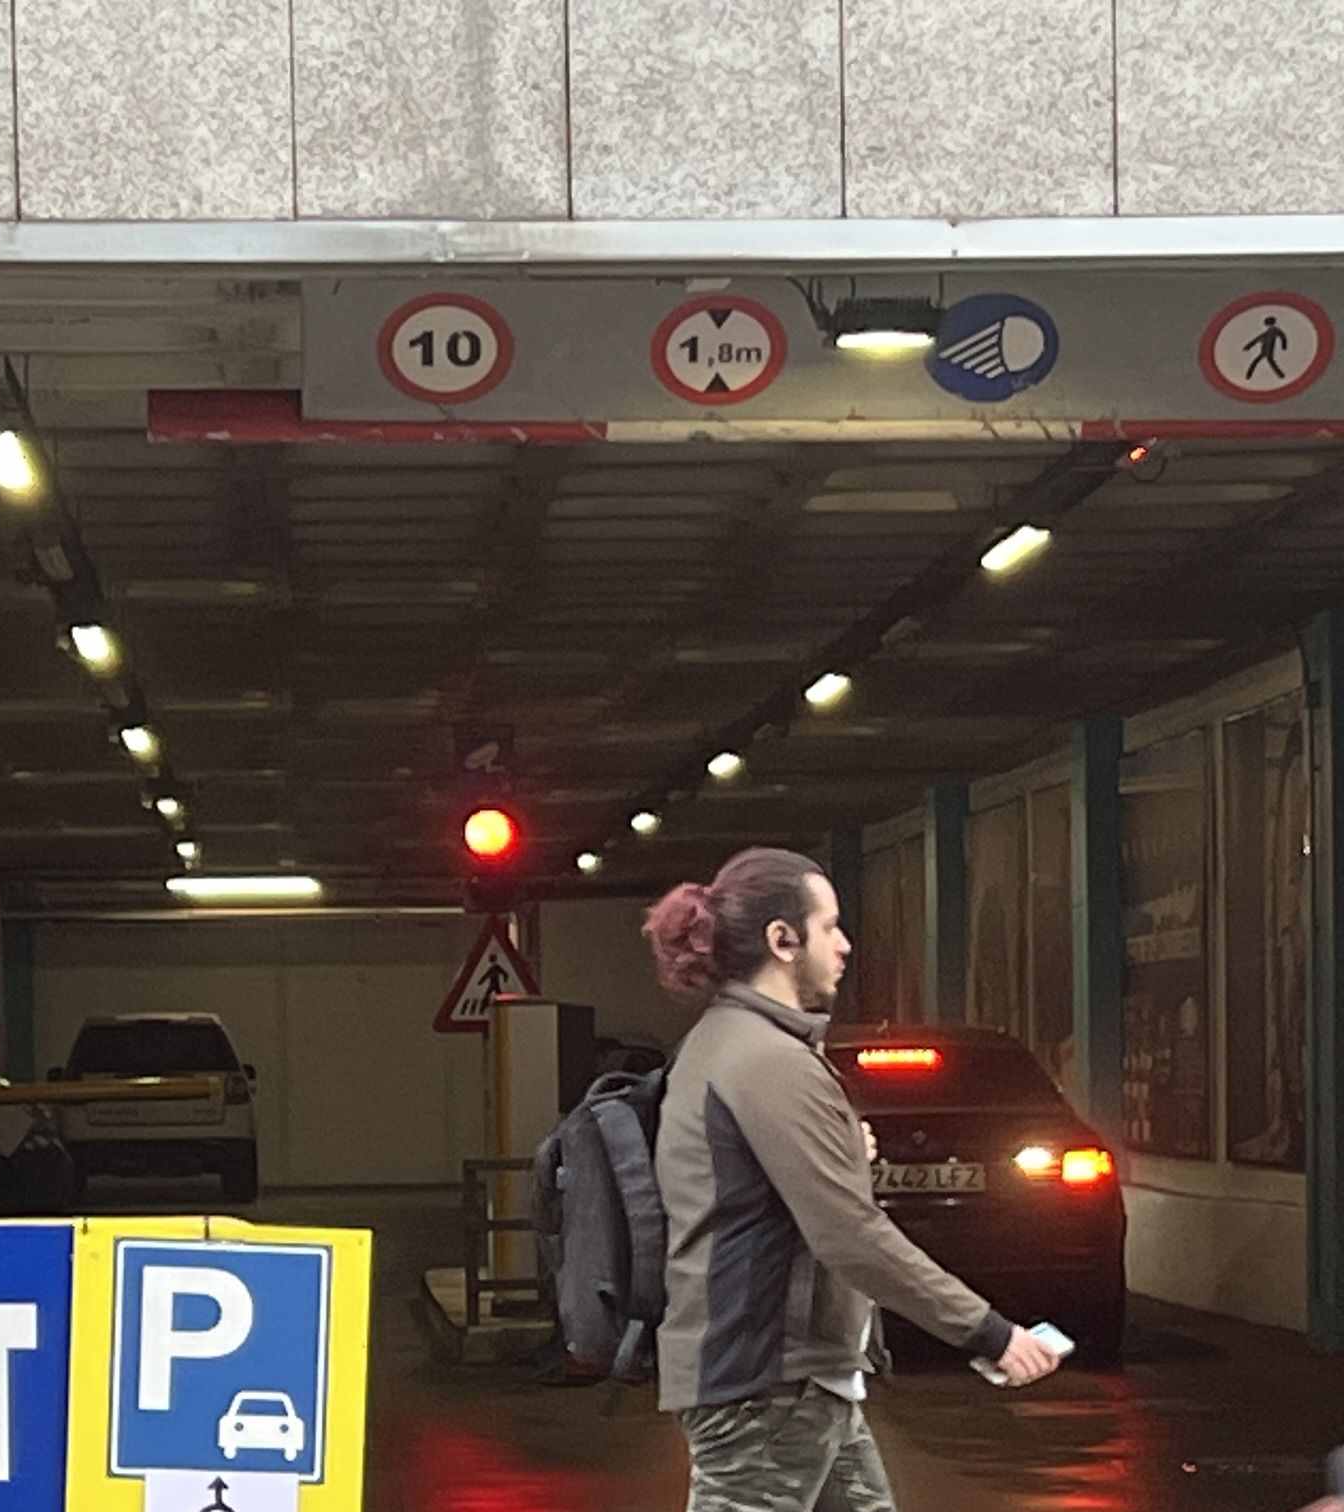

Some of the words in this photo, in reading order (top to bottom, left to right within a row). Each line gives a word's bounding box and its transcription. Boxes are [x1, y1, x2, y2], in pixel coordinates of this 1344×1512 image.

[408, 329, 482, 368] 10
[678, 335, 764, 369] 1,8m
[138, 1263, 254, 1411] P
